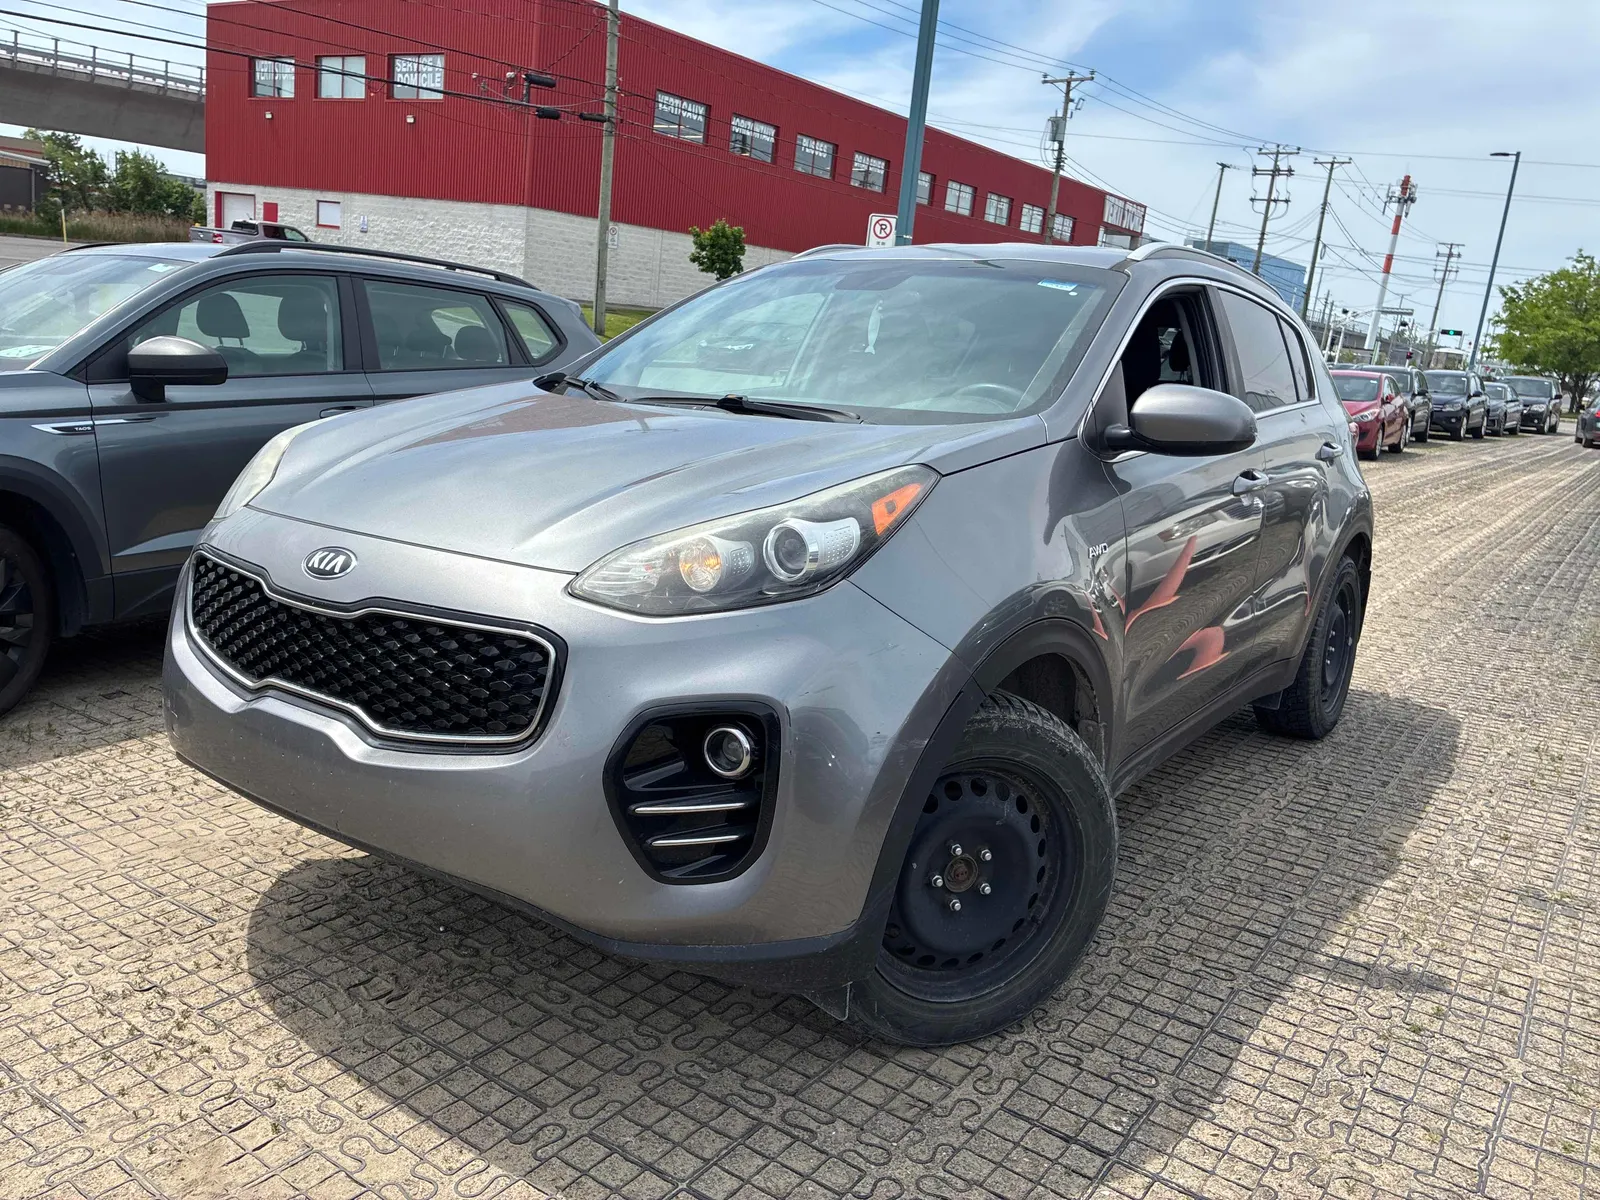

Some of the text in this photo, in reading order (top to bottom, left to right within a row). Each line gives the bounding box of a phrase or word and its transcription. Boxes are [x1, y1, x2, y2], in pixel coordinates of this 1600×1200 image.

[396, 57, 433, 72] SERVICE
[396, 72, 441, 88] DOMICILE
[657, 94, 704, 121] VERTICAUX
[1089, 542, 1109, 559] AWD
[307, 551, 347, 573] KIA
